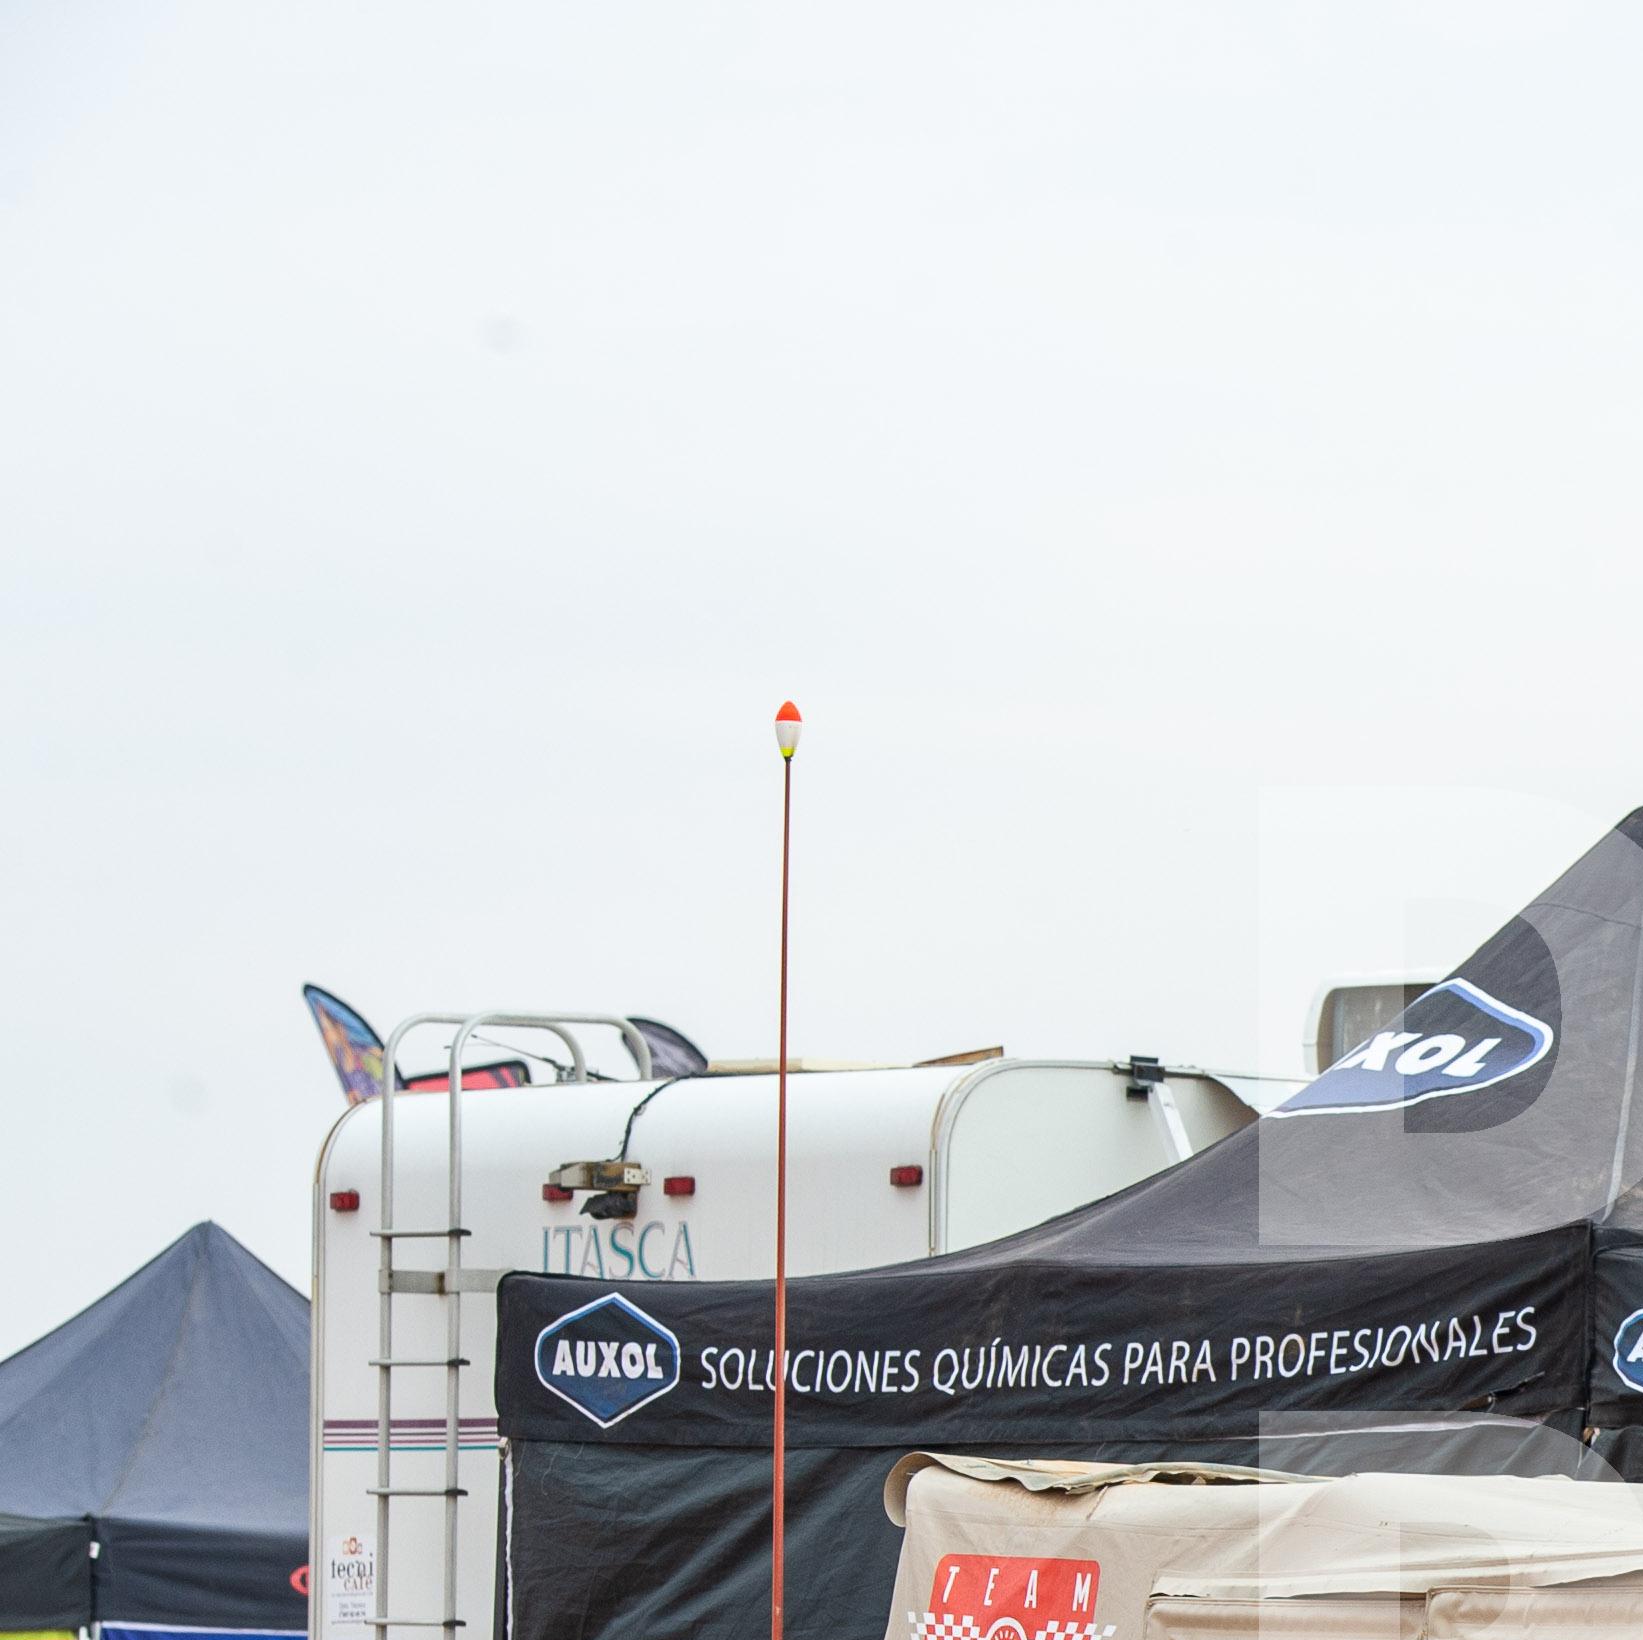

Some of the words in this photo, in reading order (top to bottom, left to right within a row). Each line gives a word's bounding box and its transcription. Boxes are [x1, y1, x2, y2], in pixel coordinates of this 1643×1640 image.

[1333, 1031, 1502, 1077] XOL
[542, 1220, 696, 1280] ITASCA
[553, 1339, 663, 1380] AUXOL
[700, 1346, 920, 1393] SOLUCIONES
[932, 1336, 1110, 1397] QUÍMICAS
[1124, 1339, 1216, 1386] PARA
[1231, 1306, 1537, 1381] PROFESIONALES
[941, 1566, 1091, 1613] TEAM
